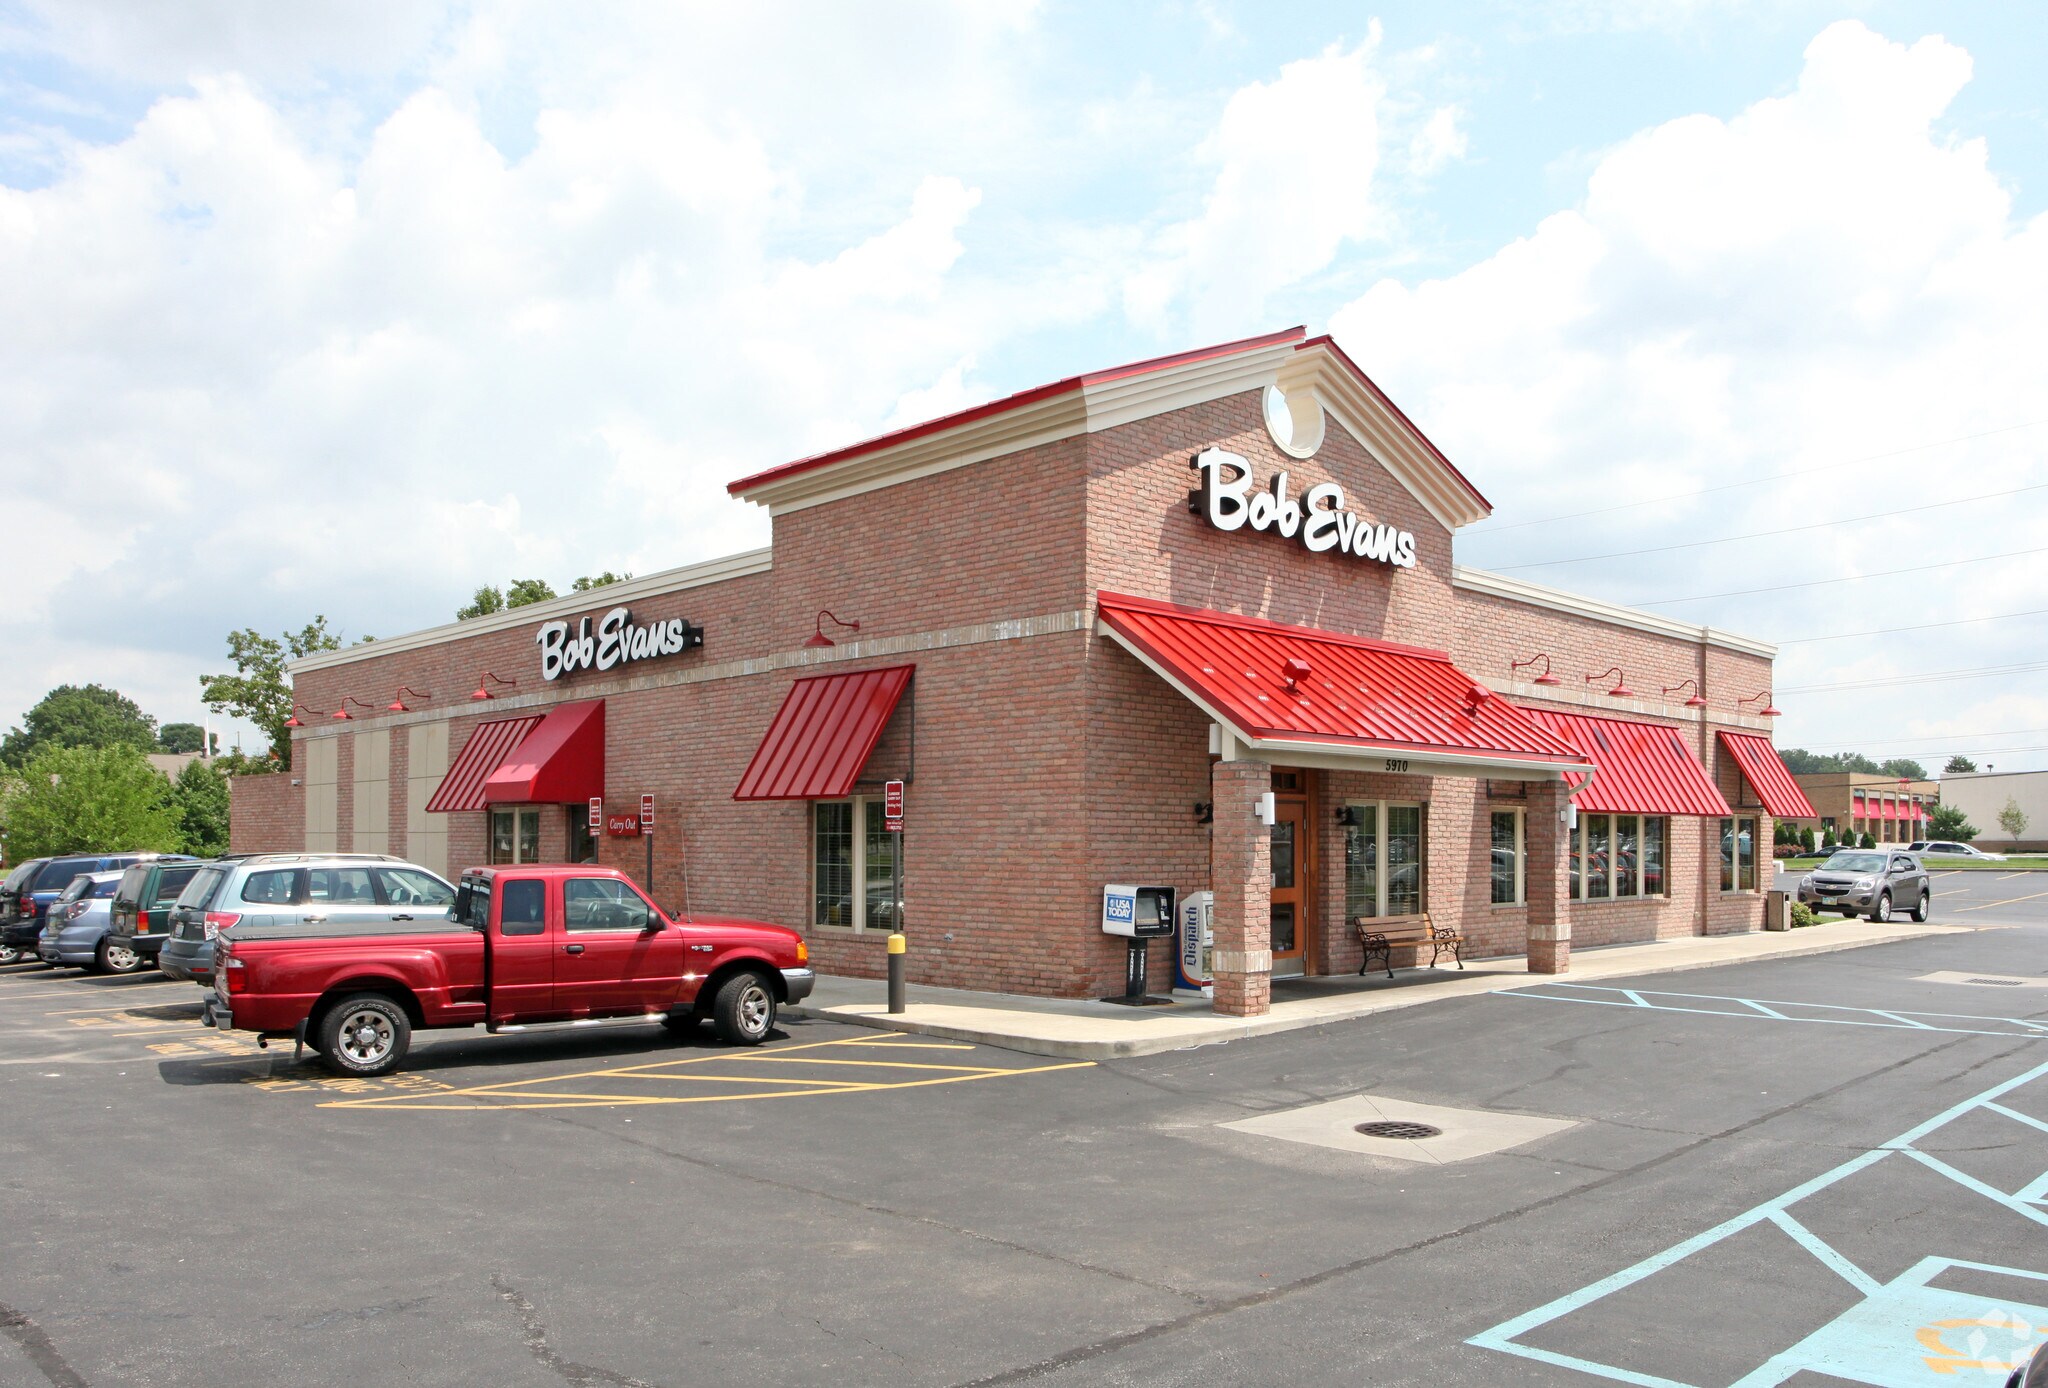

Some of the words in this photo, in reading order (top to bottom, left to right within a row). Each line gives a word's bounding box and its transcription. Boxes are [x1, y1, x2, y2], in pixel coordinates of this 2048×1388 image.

[1198, 446, 1300, 538] Bob
[1303, 482, 1416, 569] Evans
[536, 616, 595, 681] Bob
[596, 607, 684, 671] Evans
[1385, 759, 1409, 773] 5970
[609, 818, 624, 834] Carry
[625, 818, 636, 830] Out
[1116, 900, 1130, 908] USA
[1108, 907, 1131, 918] TODAY
[1184, 907, 1199, 967] Dispatch
